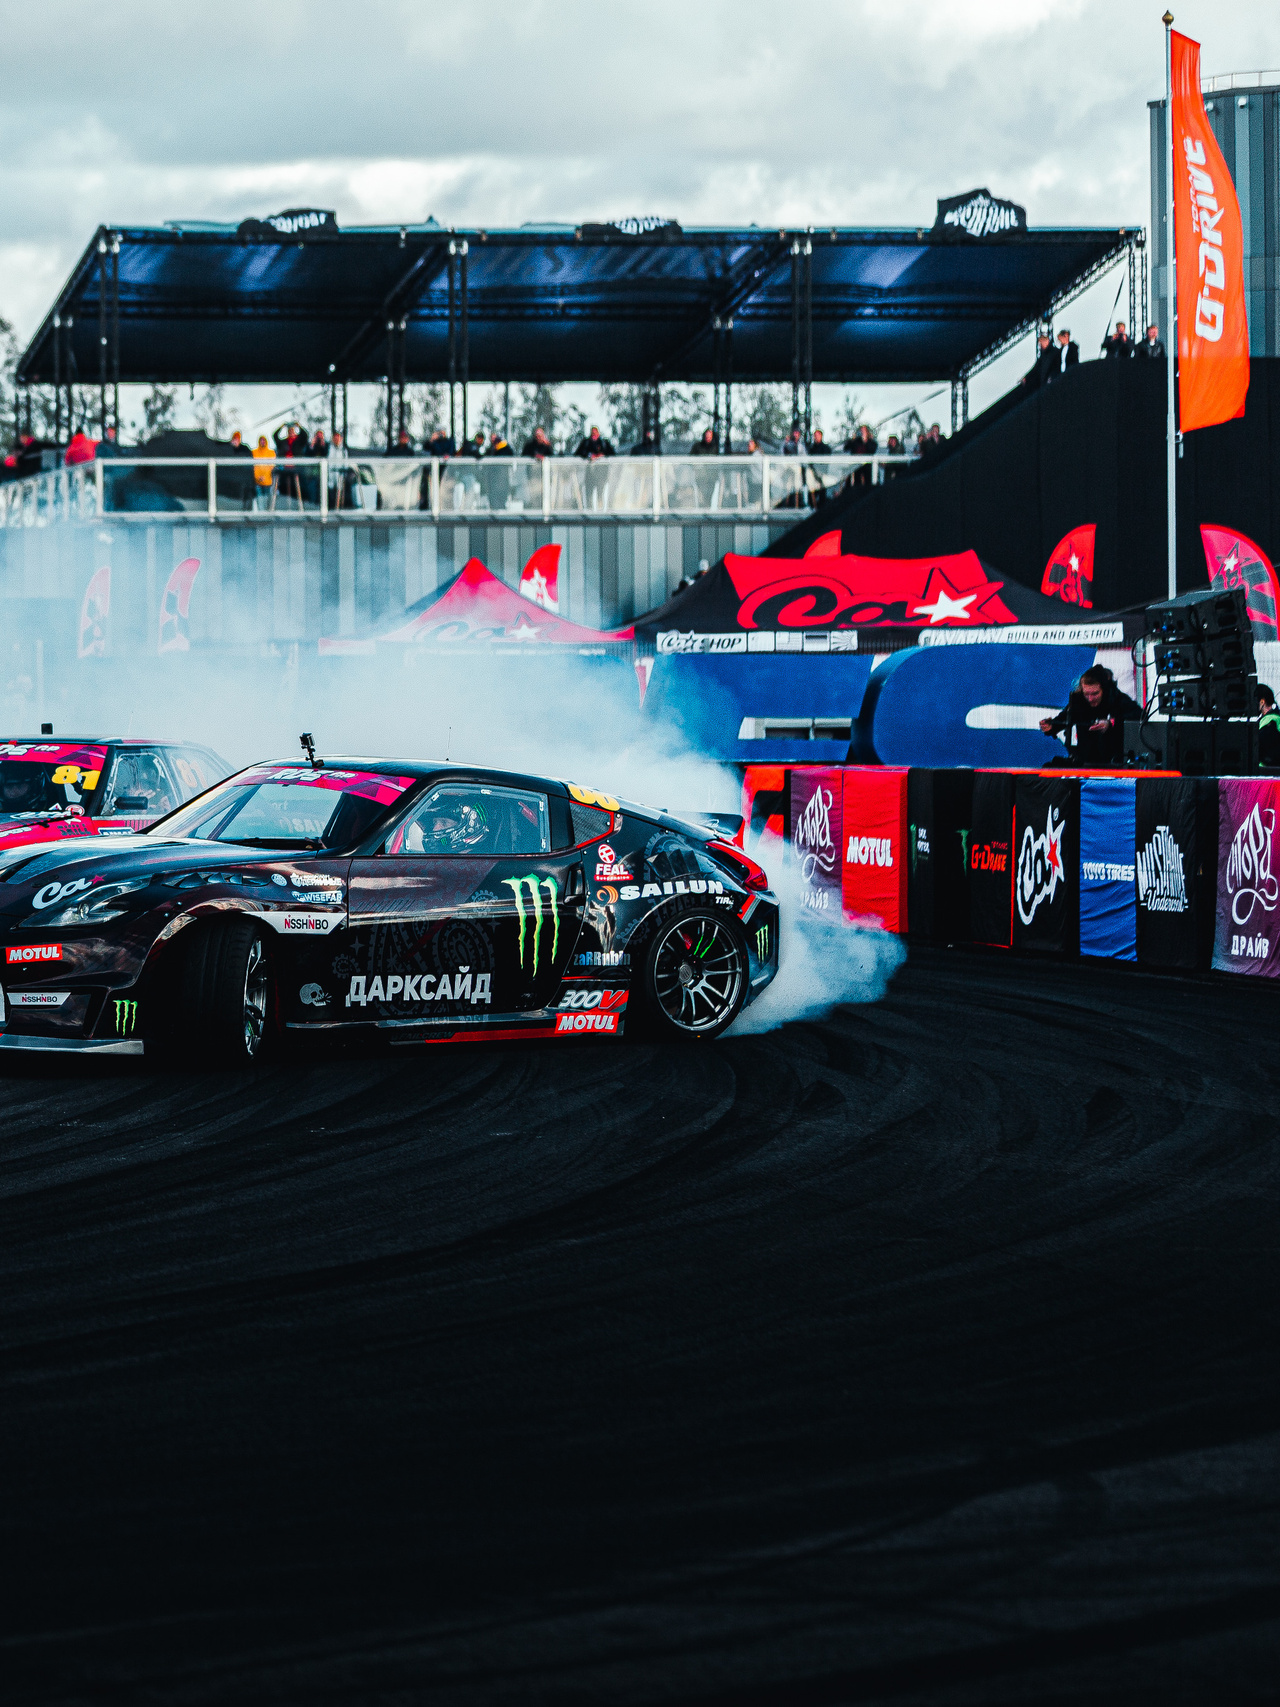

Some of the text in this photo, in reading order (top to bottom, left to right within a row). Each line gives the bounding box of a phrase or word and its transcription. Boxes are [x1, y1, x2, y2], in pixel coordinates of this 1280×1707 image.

[1042, 630, 1065, 641] AND
[1069, 628, 1117, 640] DESTROY
[51, 765, 101, 791] 81
[846, 835, 894, 867] MOTUL
[595, 863, 629, 875] FEAL
[1083, 862, 1135, 882] TOYO TIRES
[304, 893, 342, 903] WISEFAB
[620, 880, 724, 901] SAILUN
[8, 946, 60, 961] MOTUL
[1231, 932, 1270, 959] ДРАЙВ
[345, 965, 492, 1007] ДАРКСАЙД
[558, 989, 625, 1010] 300V
[557, 1014, 616, 1032] MOTUL
